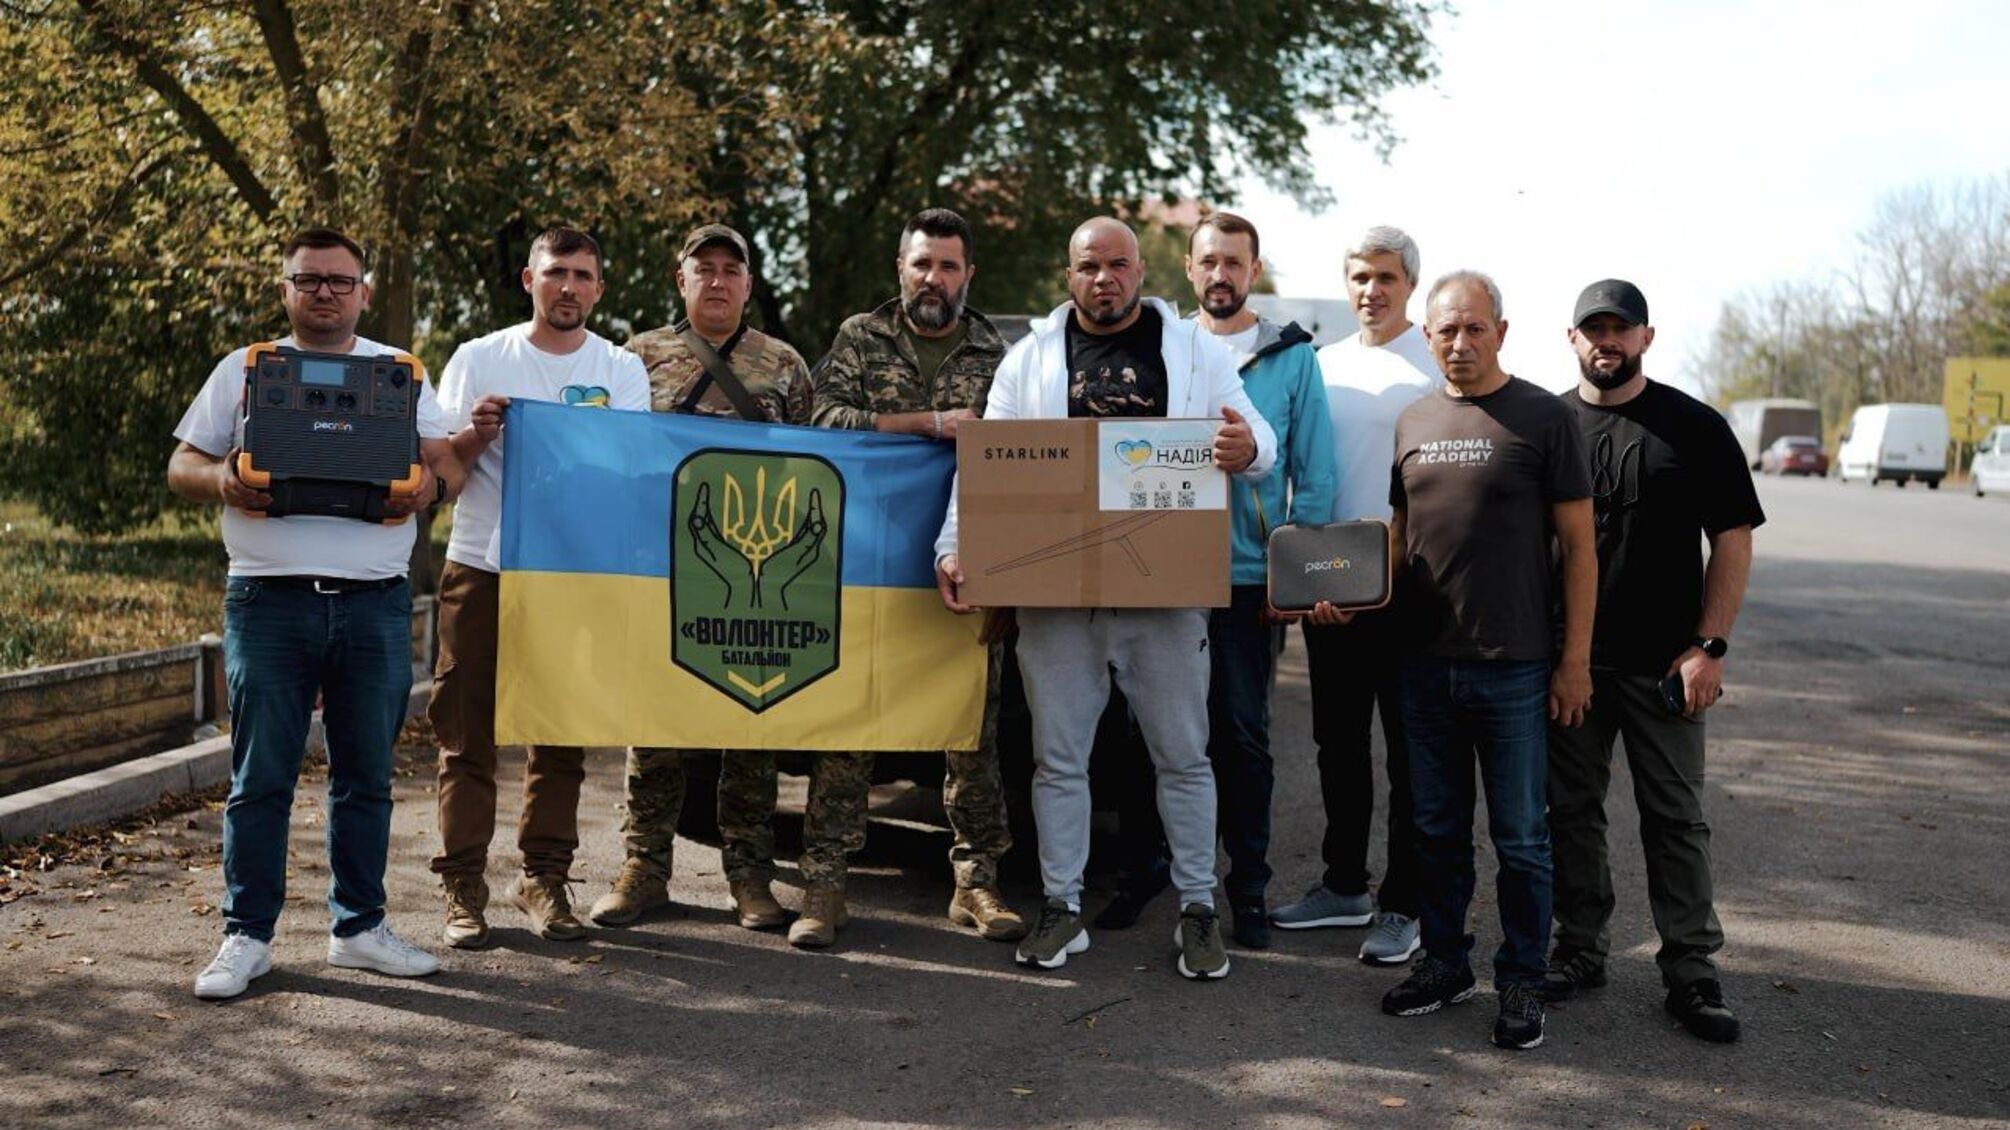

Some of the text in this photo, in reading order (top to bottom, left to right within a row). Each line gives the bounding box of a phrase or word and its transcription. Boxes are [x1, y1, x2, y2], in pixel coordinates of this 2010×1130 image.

[984, 447, 1069, 460] STARLINK
[1420, 438, 1494, 453] NATIONAL
[1156, 447, 1213, 465] НАДІЯ
[1418, 450, 1493, 465] ACADEMY
[1304, 554, 1351, 574] pecron
[680, 616, 831, 649] «ВОЛОНТЕР»
[721, 649, 792, 667] БАТАЛЬЙОН
